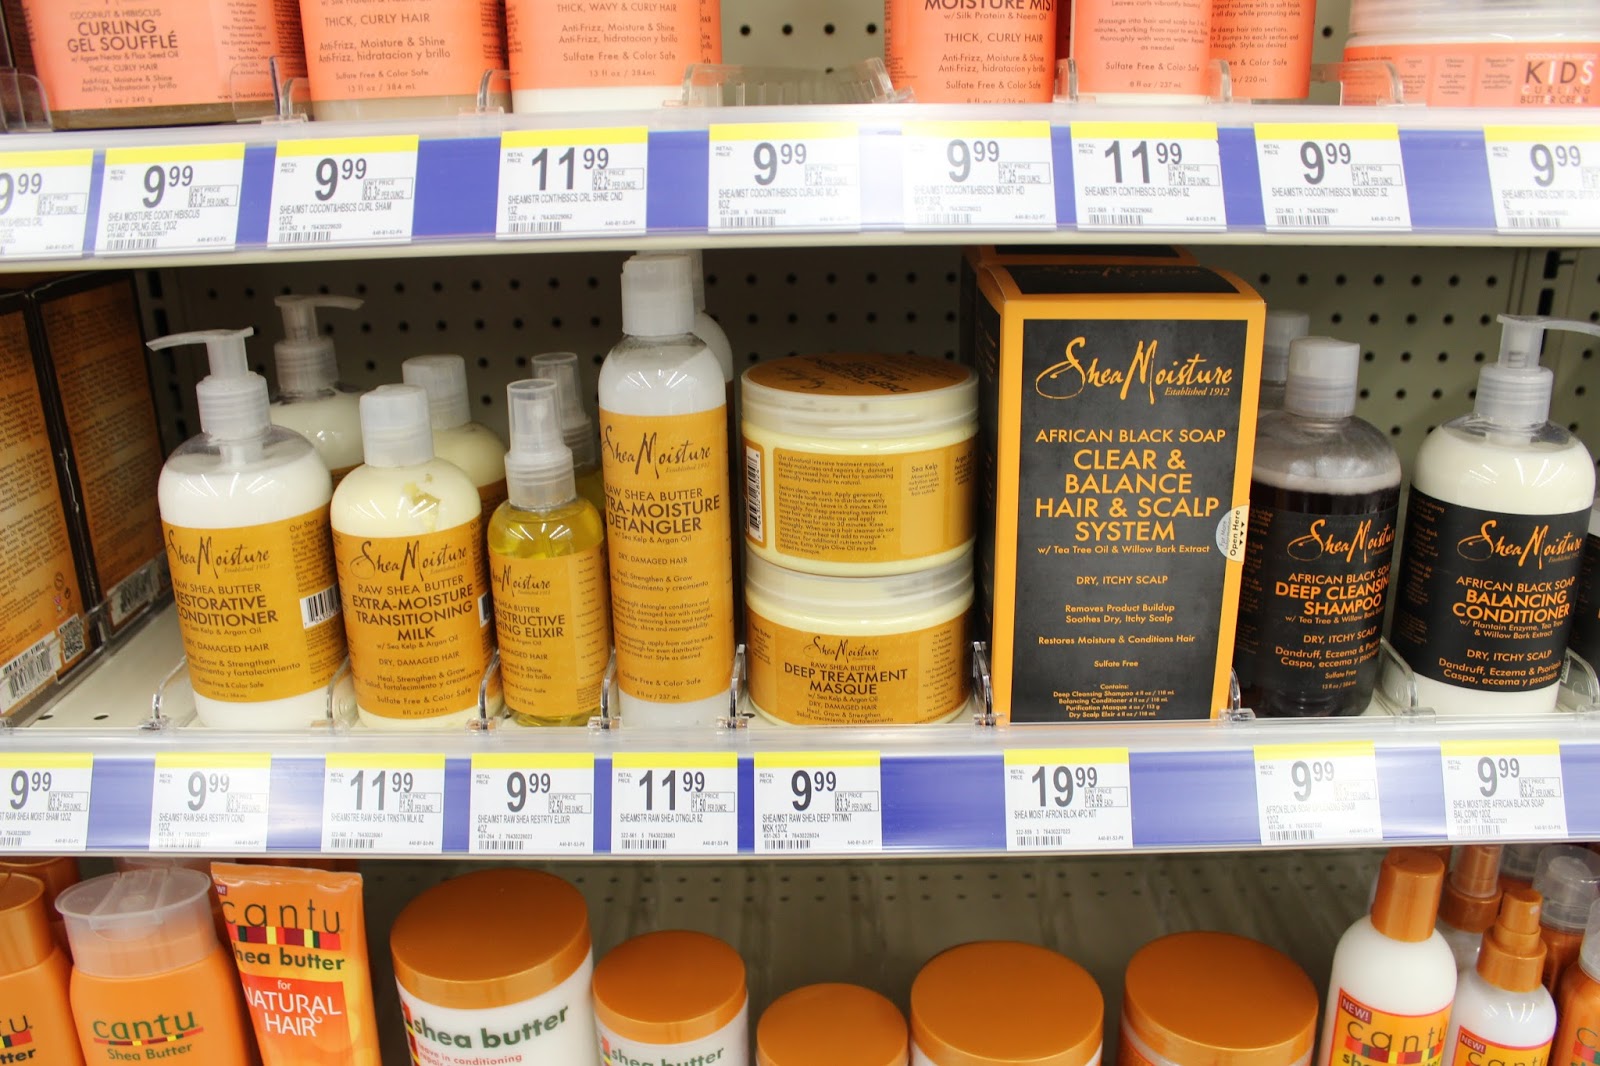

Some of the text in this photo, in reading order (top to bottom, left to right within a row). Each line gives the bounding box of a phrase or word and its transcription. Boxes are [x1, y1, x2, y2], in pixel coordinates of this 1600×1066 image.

[78, 19, 157, 37] CURLING
[325, 13, 430, 27] THICK, CURLY HAIR
[68, 30, 178, 52] GEL SOUFFLÉ
[945, 33, 1043, 43] THICK, CURLY HAIR
[1165, 387, 1230, 396] Established 1912
[1036, 429, 1226, 442] AFRICAN BLACK SOAP
[1074, 449, 1186, 470] CLEAR &
[1065, 473, 1192, 494] BALANCE
[625, 490, 655, 501] SHEA
[661, 488, 703, 501] BUTTER
[1036, 497, 1219, 518] HAIR & SCALP
[609, 512, 702, 535] DETANGLER
[1075, 521, 1175, 541] SYSTEM
[1230, 510, 1241, 556] Open Here
[1038, 545, 1209, 555] w/ Tea Tree Oil & Willow Bark Extract
[358, 575, 464, 595] RAW SHEA BUTTER
[1076, 576, 1168, 586] DRY, ITCHY SCALP
[1288, 573, 1343, 584] AFRICAN
[1346, 572, 1375, 583] BLACK
[1456, 576, 1575, 592] AFRICAN BLACK SOAP
[191, 583, 261, 595] SHEA BUTTER
[1275, 575, 1389, 600] DEEP CLEANSIN
[352, 584, 474, 611] EXTRA-MOISTURE
[1304, 593, 1381, 616] SHAMPOO
[1466, 589, 1567, 608] BALANCING
[356, 600, 473, 626] TRANSITIONING
[1065, 604, 1175, 613] Removes Product Buildup
[1453, 602, 1570, 624] CONDITIONER
[1066, 614, 1173, 625] Soothes Dry, Itchy Scalp
[397, 627, 435, 641] MILK
[525, 627, 564, 638] ELIXIR
[1039, 637, 1075, 645] Restores
[1078, 636, 1115, 644] Moisture
[1128, 635, 1173, 643] Conditions
[1176, 635, 1195, 643] Hair
[1304, 634, 1325, 645] DRY,
[1329, 633, 1355, 644] ITCHY
[379, 651, 460, 667] DRY, DAMAGED HAIR
[1275, 646, 1364, 659] Dandruff, Eczema &
[1467, 649, 1552, 662] DRY, ITCHY SCALP
[784, 662, 908, 682] DEEP TREATMENT
[809, 681, 877, 695] MASQUE
[234, 946, 345, 971] hea butter
[277, 980, 291, 990] for
[243, 985, 342, 1023] NATURAL
[1342, 998, 1369, 1021] NEW!
[93, 1011, 195, 1040] cantu
[264, 1012, 317, 1037] HAIR
[414, 1006, 568, 1049] shea butter
[107, 1043, 192, 1061] Shea Butter
[1461, 1035, 1485, 1052] NEW!
